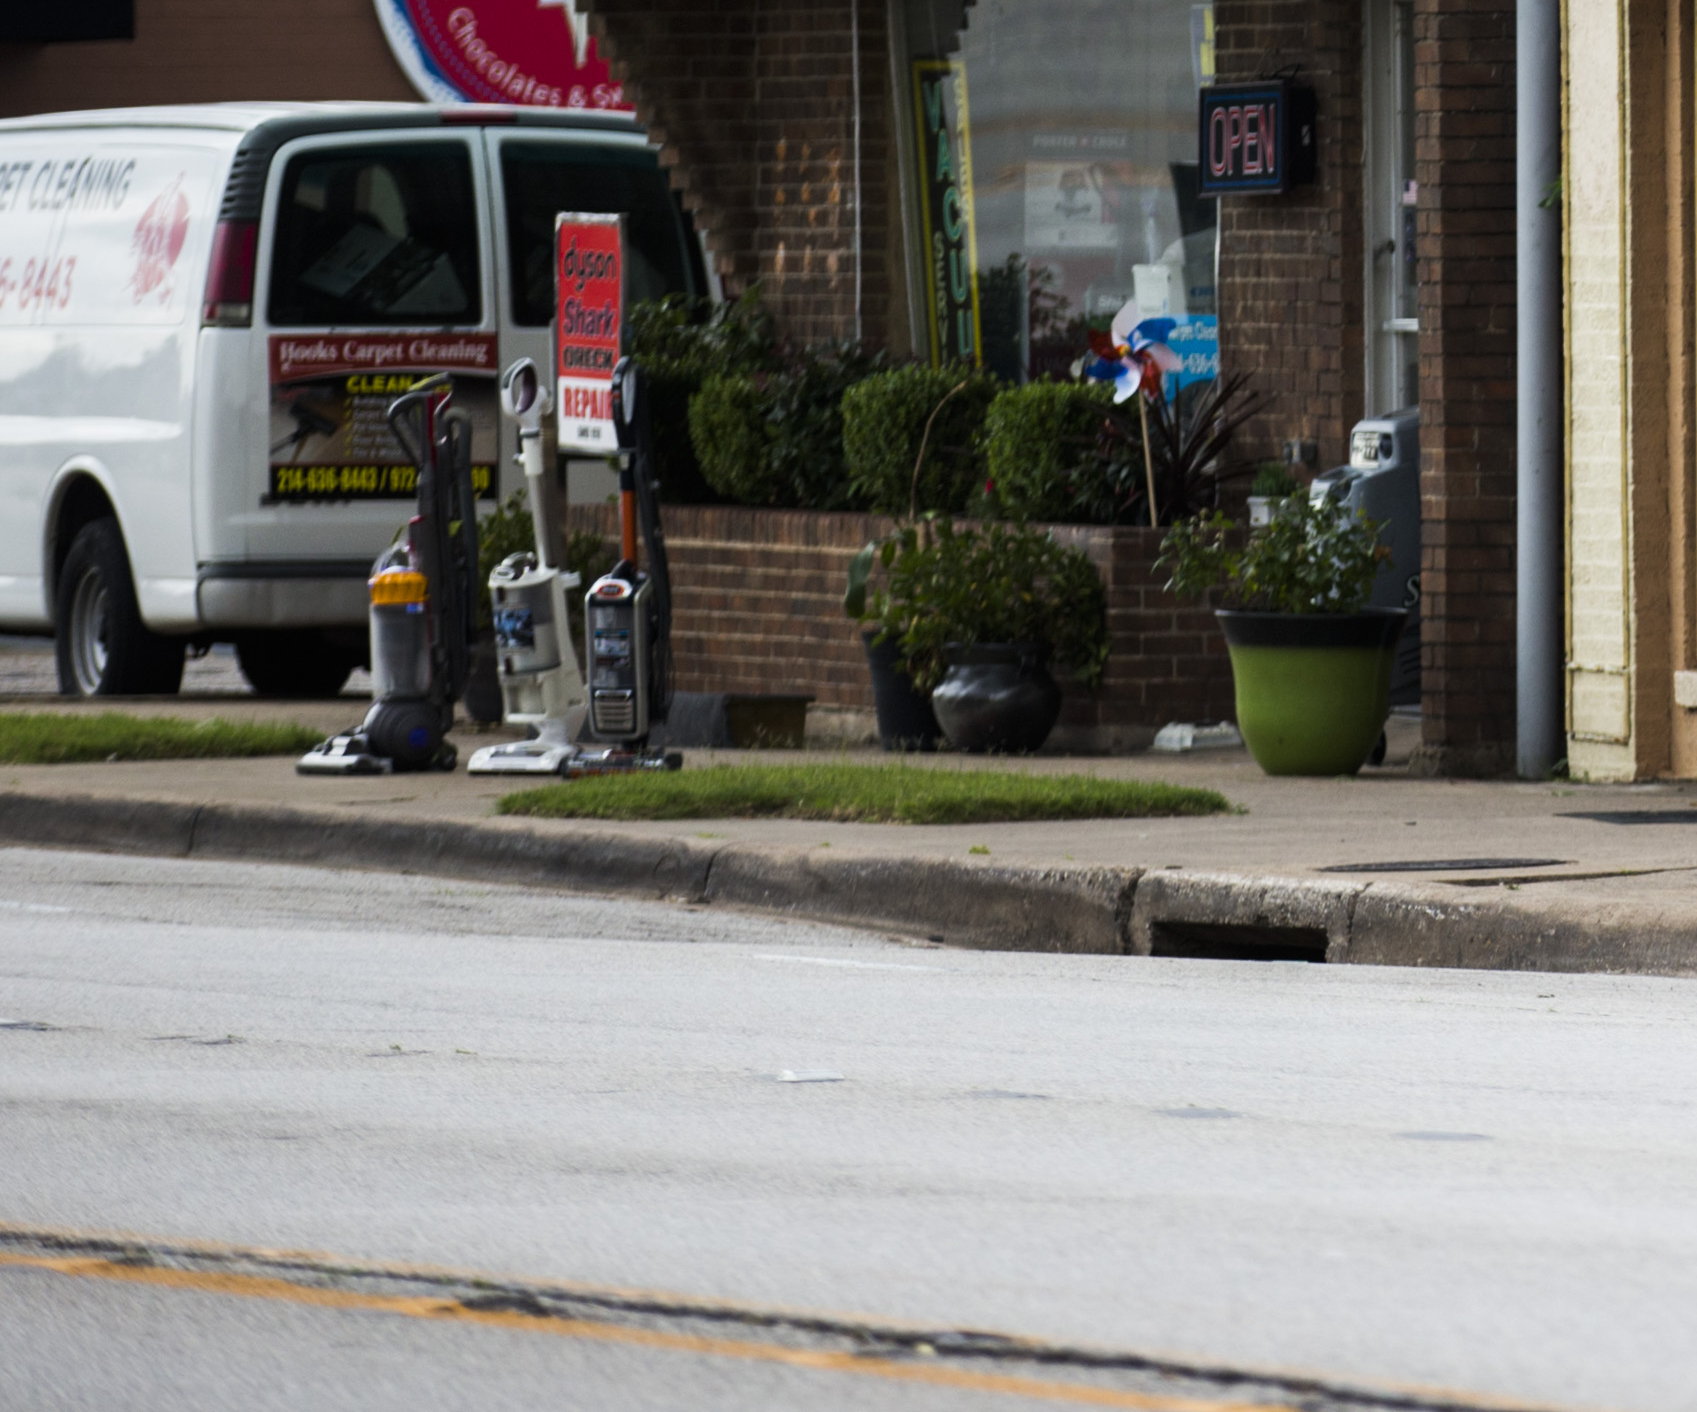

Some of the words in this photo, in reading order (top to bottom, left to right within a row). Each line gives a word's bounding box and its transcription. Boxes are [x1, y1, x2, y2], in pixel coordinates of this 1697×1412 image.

[448, 6, 562, 107] Chocolates
[567, 84, 588, 107] &
[1209, 103, 1276, 178] OPEN
[29, 158, 138, 211] CLEANING
[564, 236, 616, 292] dyson
[563, 296, 618, 339] Shark
[279, 339, 337, 372] Hooks
[343, 340, 403, 366] Carpet
[408, 338, 489, 365] Cleaning
[563, 344, 615, 370] ORECK
